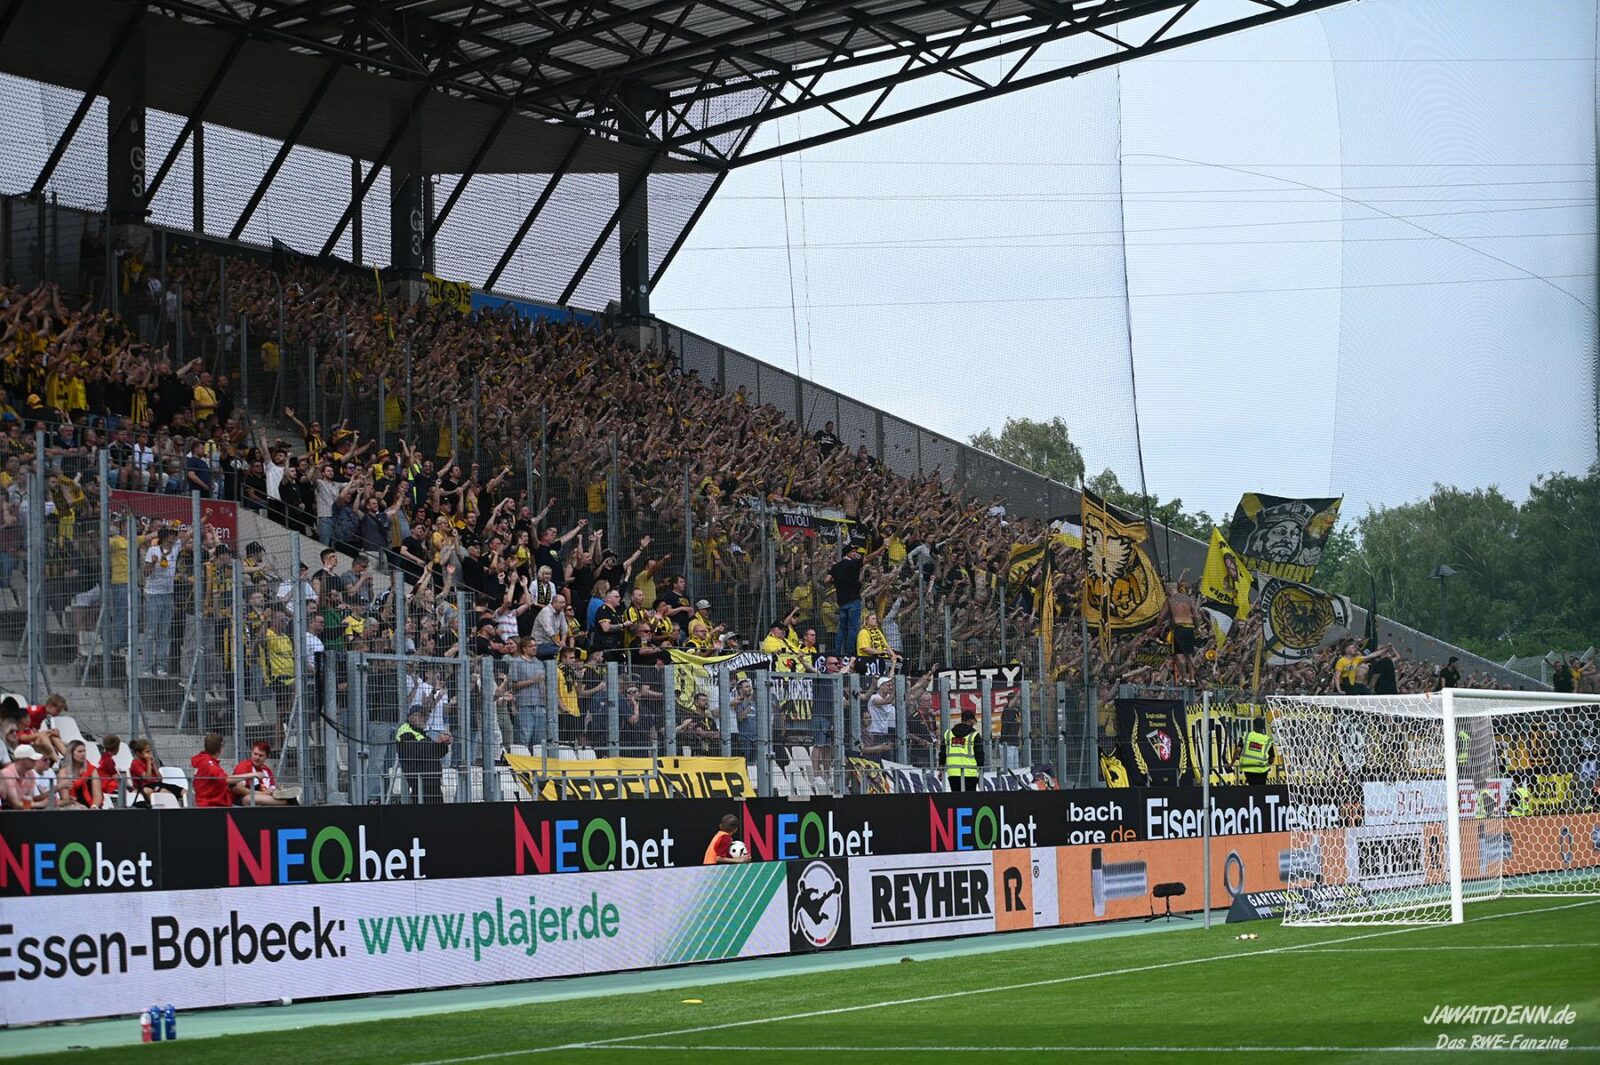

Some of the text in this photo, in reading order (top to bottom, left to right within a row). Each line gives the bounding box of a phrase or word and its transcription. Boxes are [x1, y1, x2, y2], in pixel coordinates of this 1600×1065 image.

[926, 665, 1021, 692] ASTY
[513, 803, 675, 875] NEO.bet
[741, 801, 874, 861] NEO.bet
[929, 794, 1038, 853] NEO.bet
[1066, 801, 1123, 822] bach
[1265, 794, 1339, 832] Tresore
[0, 832, 153, 896] NEO.bet
[226, 811, 427, 887] NEO.bet
[870, 868, 992, 924] REYHER
[0, 891, 621, 982] Essen-Borbeck: www.plajer.de
